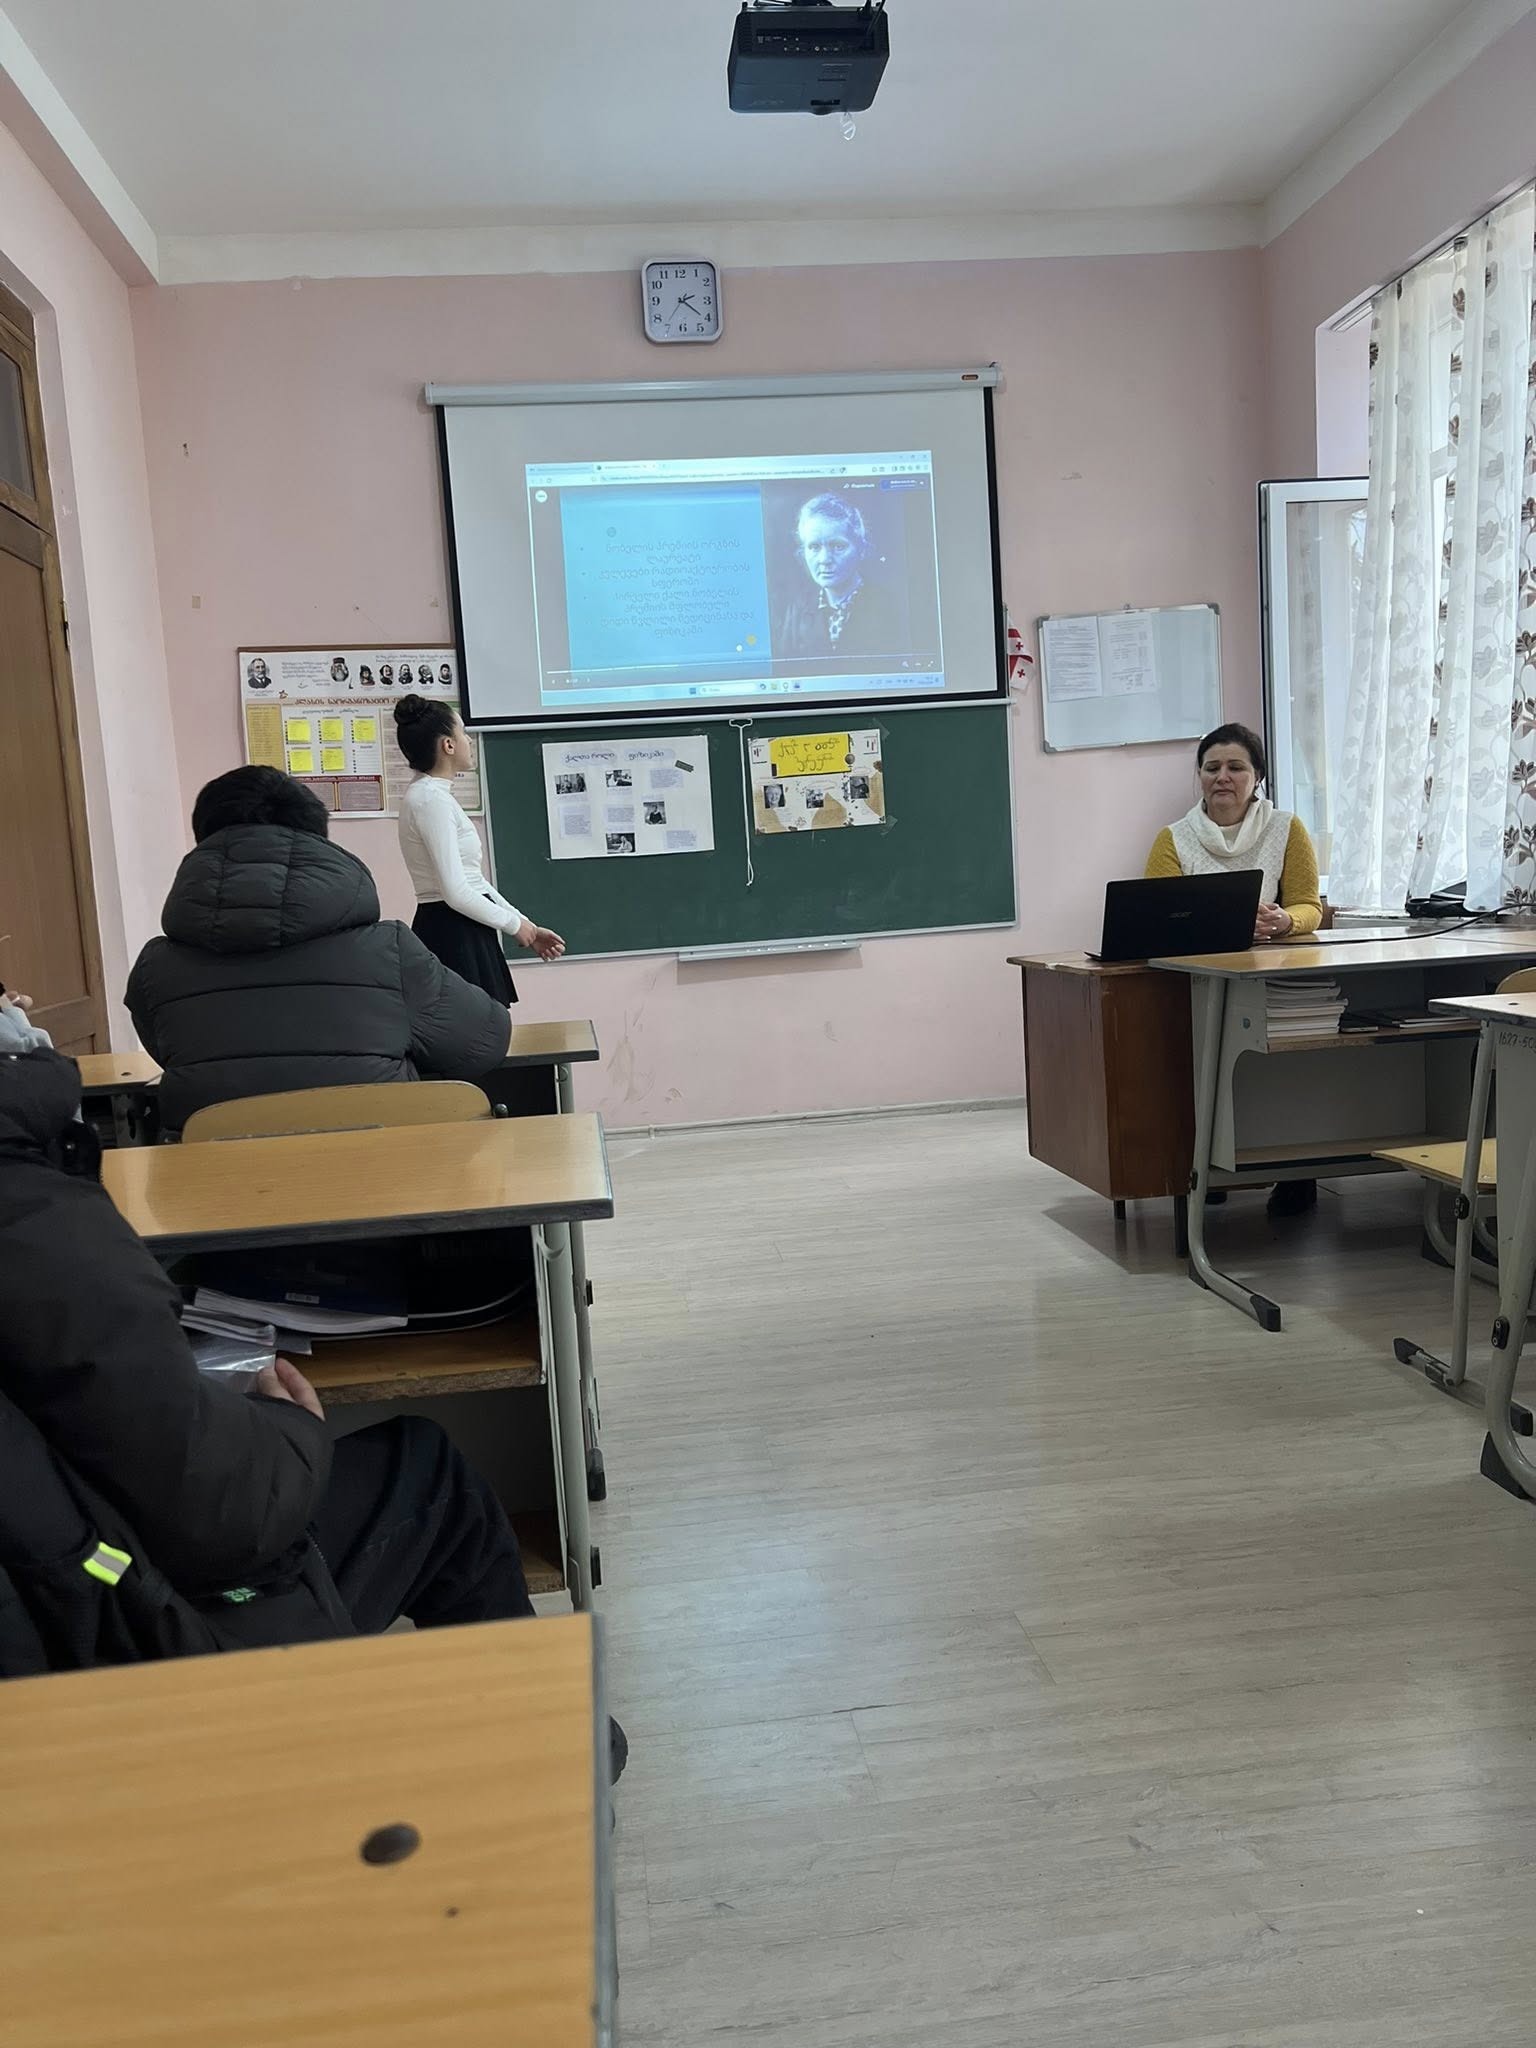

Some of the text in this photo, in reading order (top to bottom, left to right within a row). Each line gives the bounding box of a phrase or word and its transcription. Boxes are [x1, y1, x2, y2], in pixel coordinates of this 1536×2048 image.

[660, 270, 668, 279] 11
[674, 269, 686, 279] 12
[694, 268, 698, 278] 1
[652, 280, 663, 289] 10
[703, 277, 710, 287] 2
[652, 296, 661, 306] 9
[703, 296, 711, 305] 3
[653, 314, 662, 323] 8
[704, 312, 711, 322] 4
[664, 323, 671, 334] 7
[679, 323, 687, 332] 6
[697, 322, 705, 332] 5
